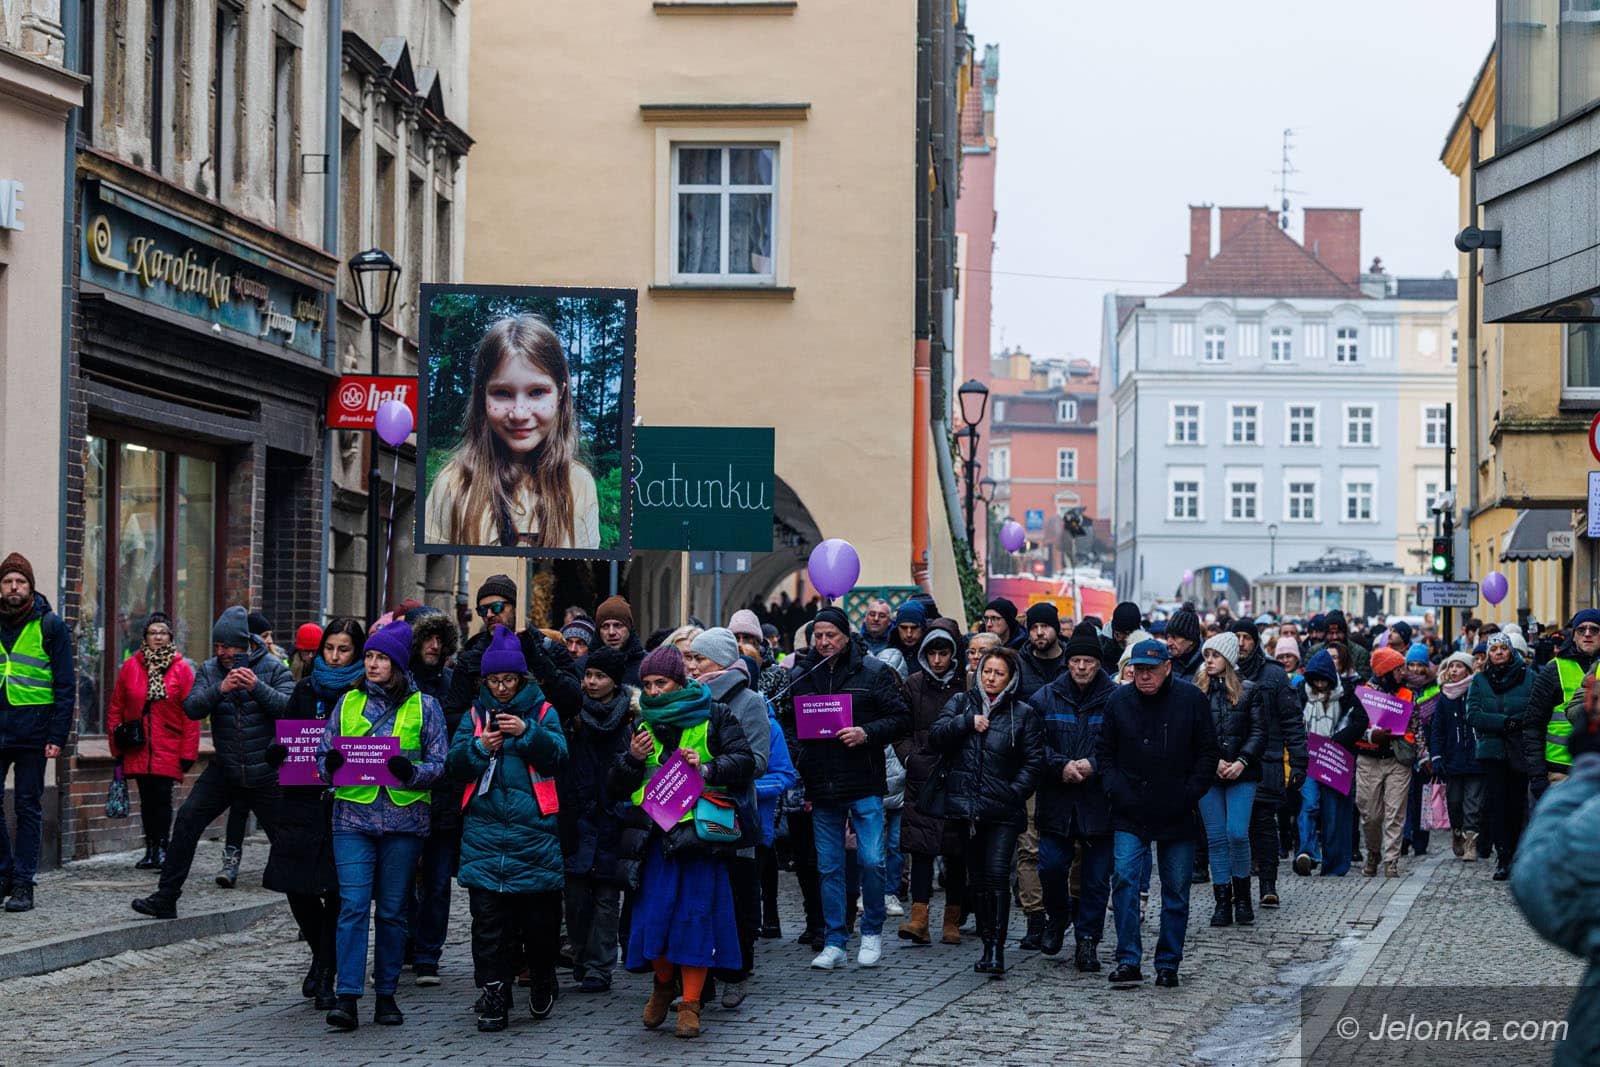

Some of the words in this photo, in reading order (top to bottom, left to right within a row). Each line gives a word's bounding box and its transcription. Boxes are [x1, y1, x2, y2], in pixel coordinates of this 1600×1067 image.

[129, 236, 231, 309] Karolinka
[646, 789, 656, 800] CZY
[655, 778, 666, 791] JAKO
[664, 760, 682, 780] DOROŚLI
[659, 790, 675, 806] NASZE
